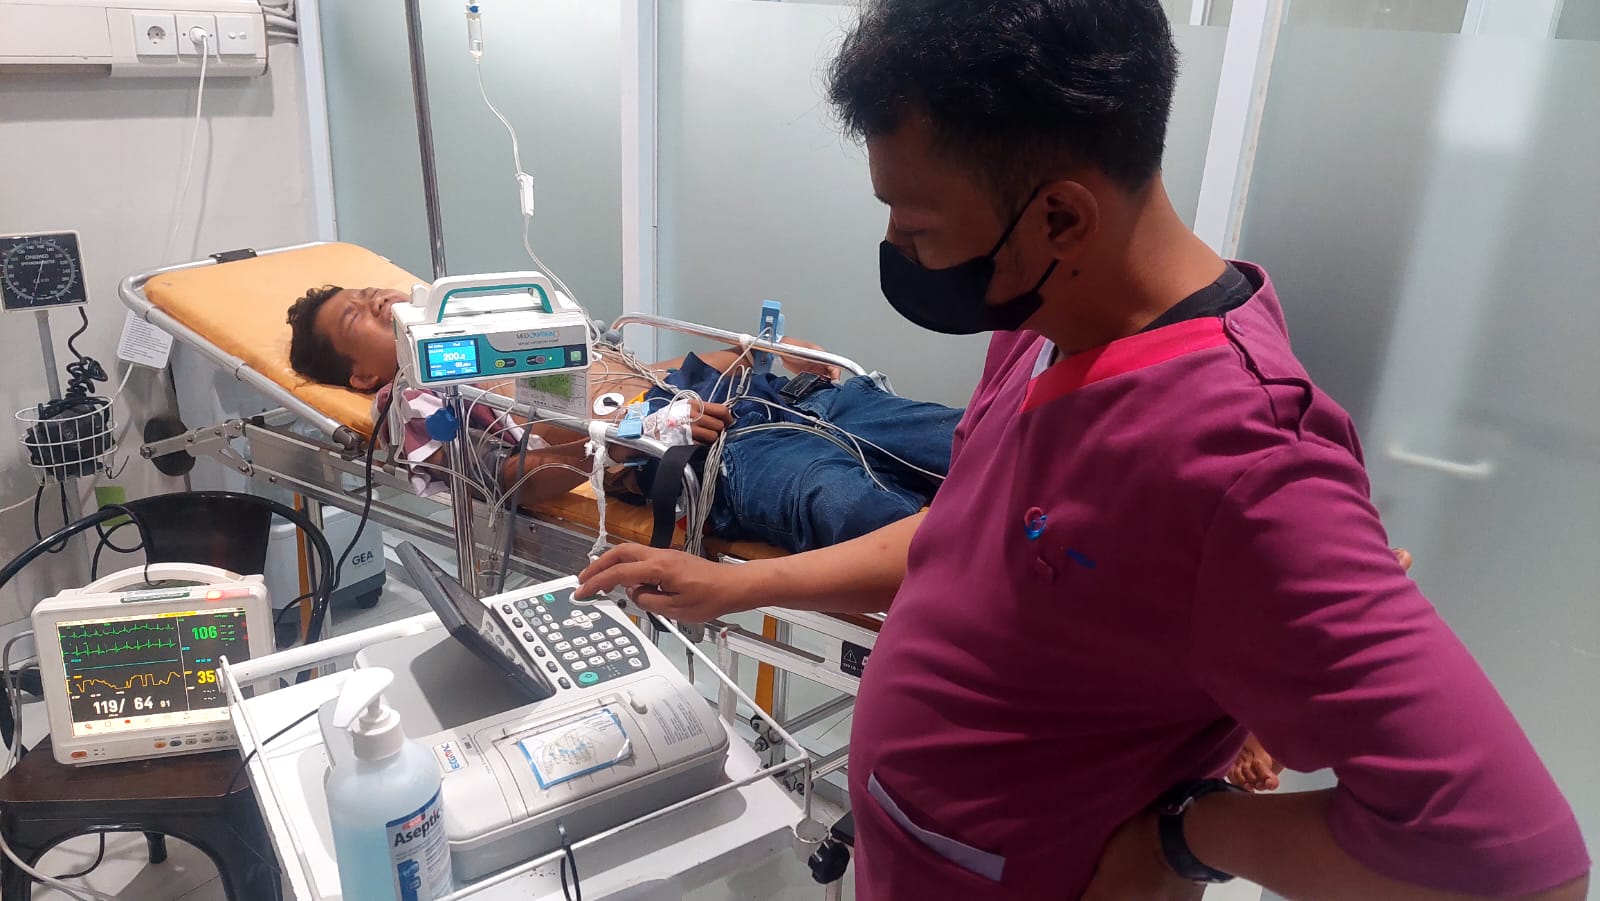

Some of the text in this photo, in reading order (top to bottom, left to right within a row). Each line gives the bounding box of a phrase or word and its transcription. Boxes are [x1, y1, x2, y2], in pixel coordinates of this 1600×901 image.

[352, 550, 374, 566] GEA
[192, 626, 217, 640] 106
[197, 670, 216, 685] 35
[134, 695, 154, 710] 64
[394, 808, 441, 847] Aseptic
